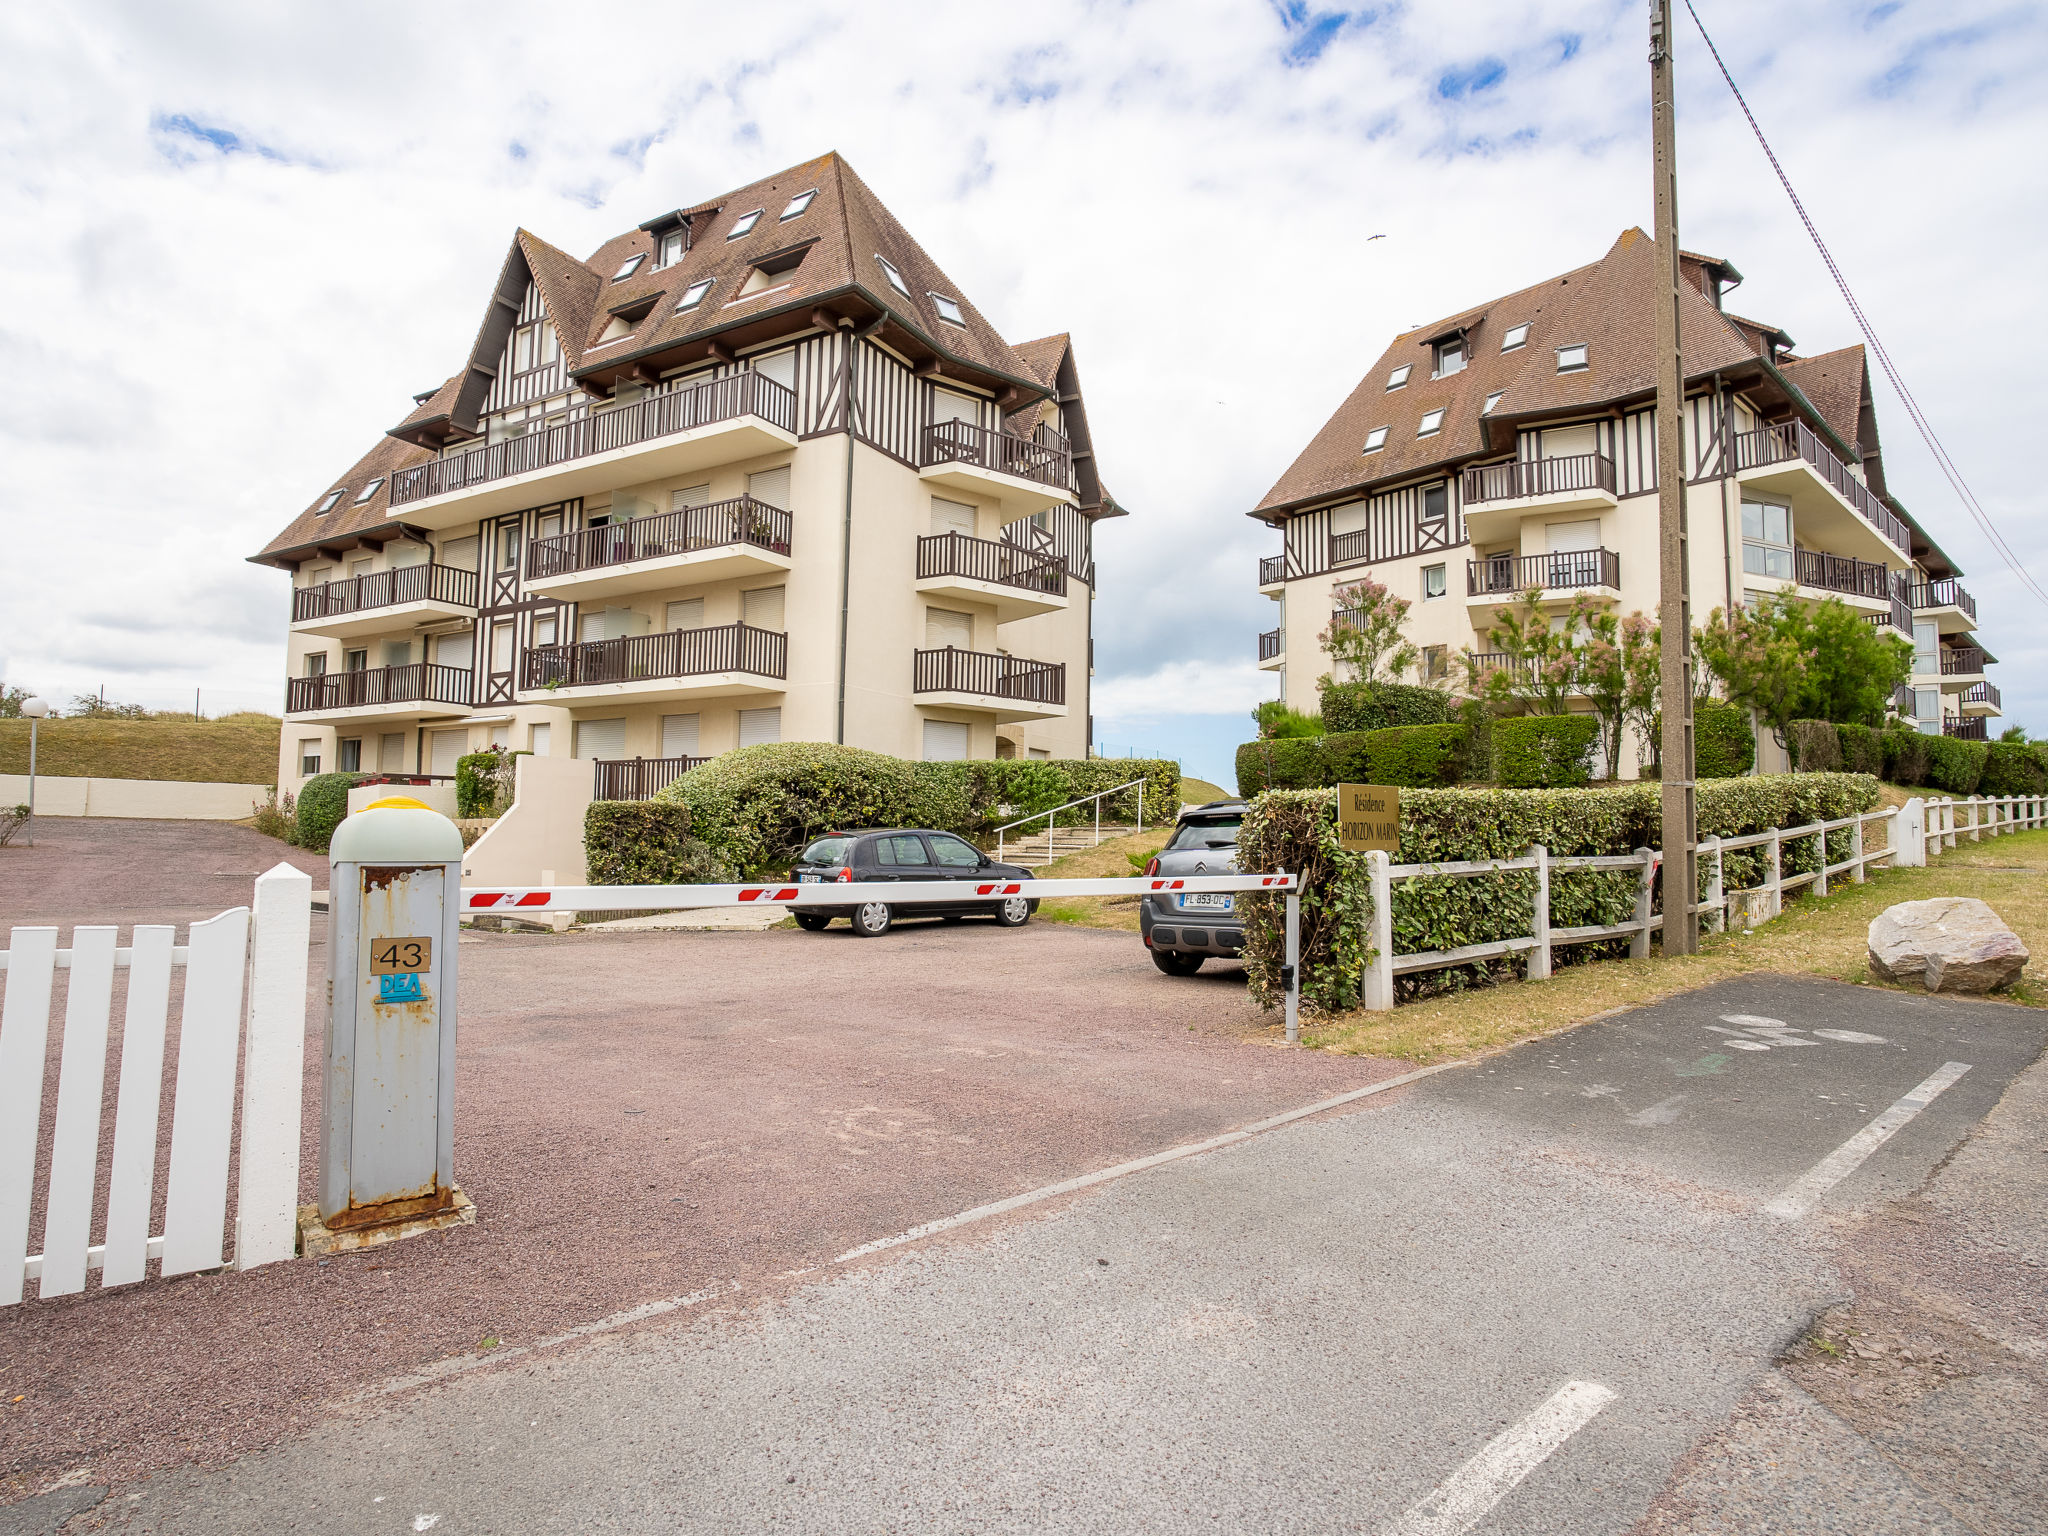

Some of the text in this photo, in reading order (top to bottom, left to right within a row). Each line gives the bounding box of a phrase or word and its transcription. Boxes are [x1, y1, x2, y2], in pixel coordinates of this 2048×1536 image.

[1354, 793, 1385, 813] Résidence
[1342, 822, 1398, 841] HORIZON MARIN
[379, 943, 422, 968] 43
[380, 972, 422, 996] DEA
